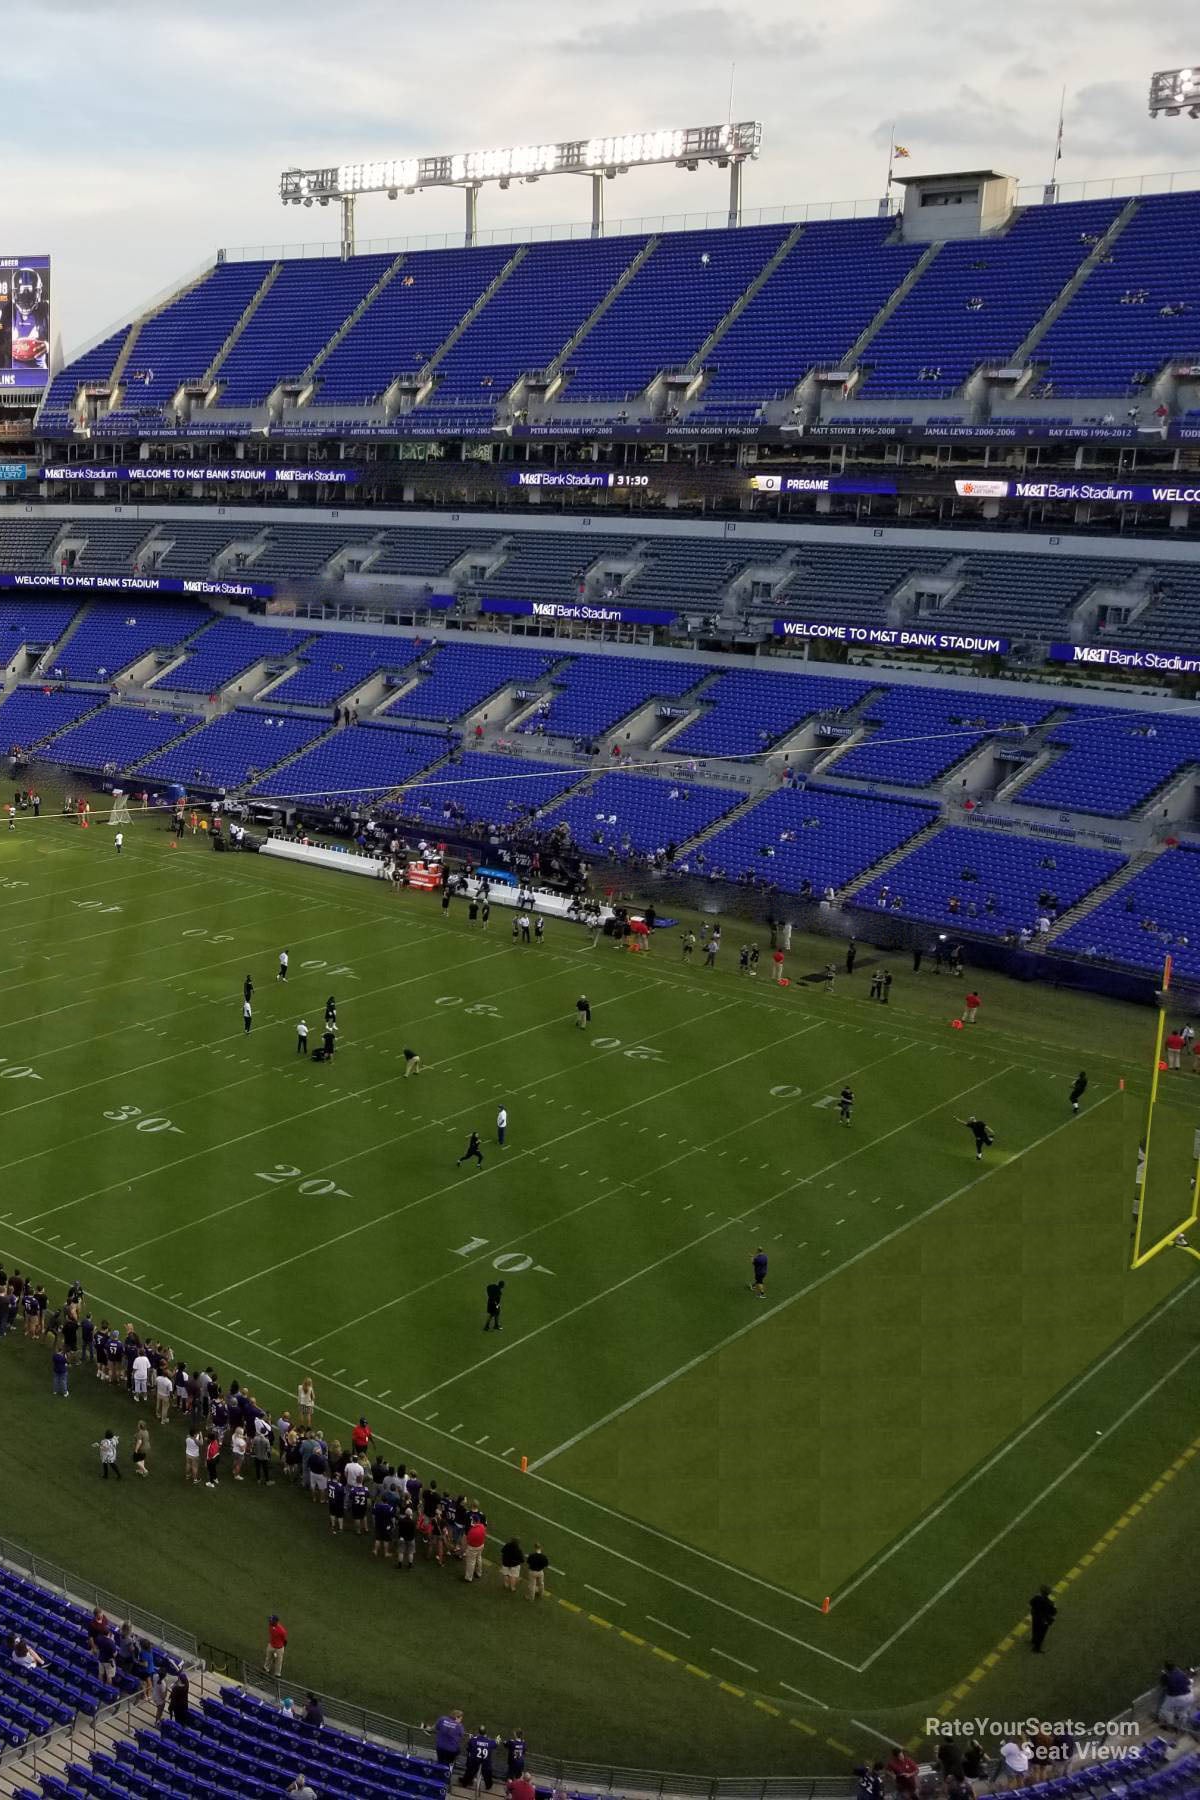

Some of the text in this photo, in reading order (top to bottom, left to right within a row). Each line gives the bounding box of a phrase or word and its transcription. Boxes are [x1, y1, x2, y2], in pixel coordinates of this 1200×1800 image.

[810, 427, 828, 435] MATT
[829, 427, 856, 435] STOVER
[924, 428, 1016, 436] JAMAL LEWIS 2000-2006
[1049, 429, 1131, 437] RAY LEWIS 1996-2012
[45, 469, 118, 480] M&T Bank Stadium
[128, 470, 266, 480] WELCOME TO M&T BANK STADIUM
[275, 470, 346, 482] M&T Bank Stadium
[519, 473, 649, 486] M&T Bank Stadium 31:30
[786, 479, 829, 490] PREGAME
[1016, 483, 1048, 497] M&T
[1048, 484, 1080, 498] Bank
[1080, 485, 1133, 500] Stadium
[14, 575, 159, 589] WELCOME TO M&T BANK STADIUM
[183, 581, 252, 595] M&T Bank Stadium
[532, 603, 621, 621] M&T Bank Stadium
[783, 622, 1000, 653] WELCOME TO M&T BANK STADIUM
[1073, 646, 1200, 672] M&T Bank Stadium
[103, 1105, 173, 1133] 30
[254, 1163, 338, 1197] 20
[448, 1236, 534, 1274] 10
[476, 1748, 488, 1759] 29
